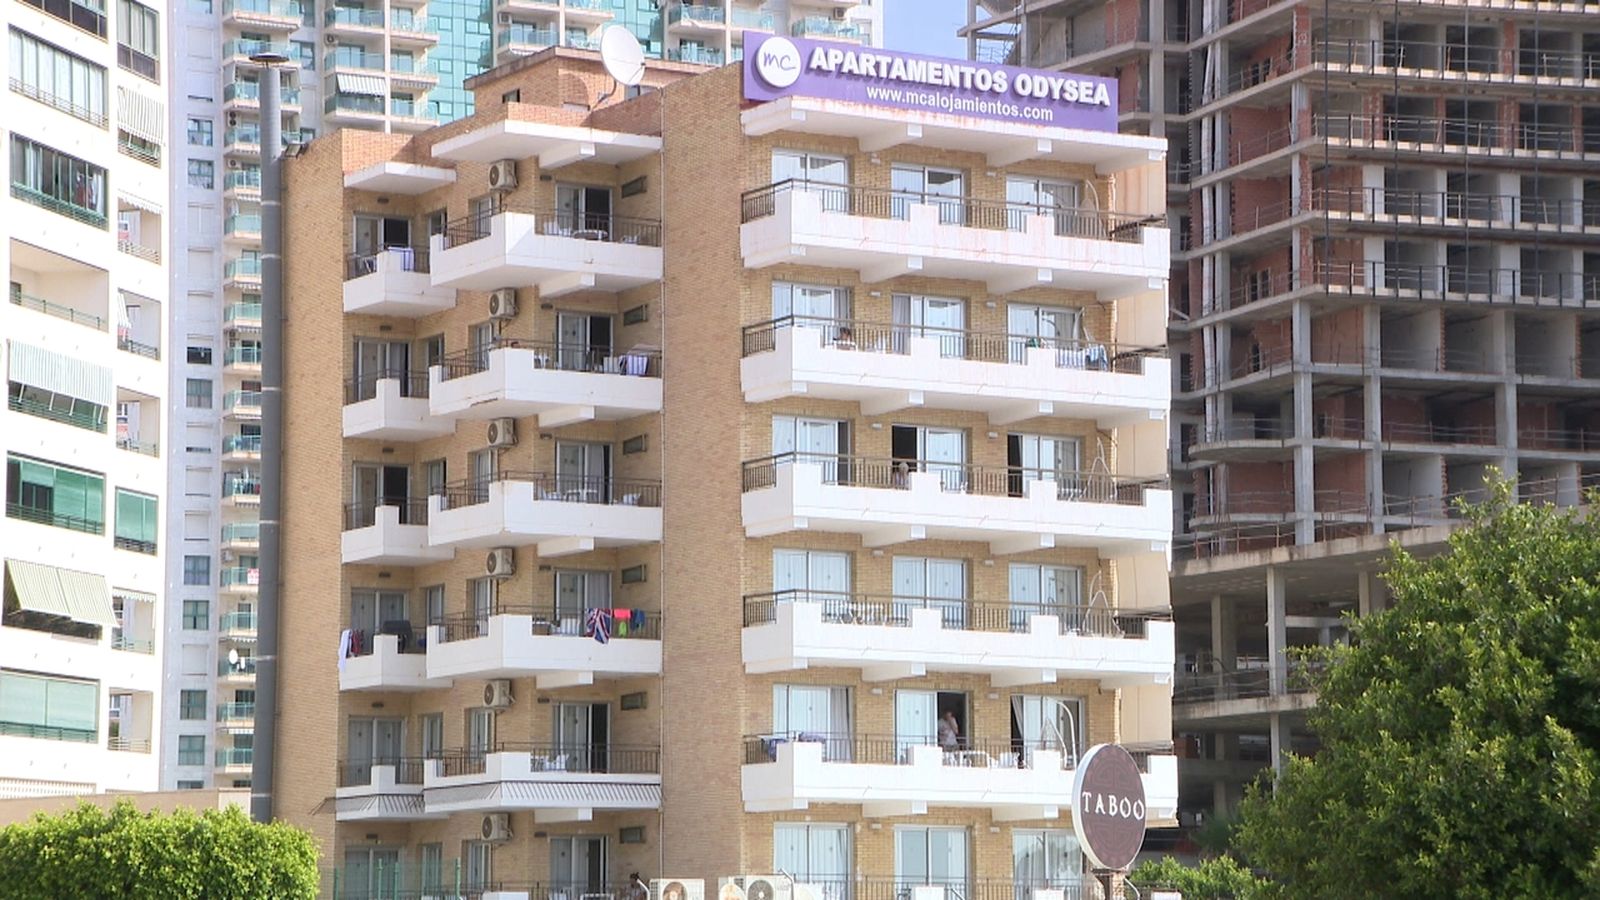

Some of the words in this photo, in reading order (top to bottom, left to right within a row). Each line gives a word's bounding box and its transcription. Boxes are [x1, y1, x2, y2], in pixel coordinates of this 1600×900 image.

[809, 46, 1008, 94] APARTAMENTOS
[1014, 73, 1111, 106] ODYSEA
[866, 86, 1054, 121] www.mcalojamientos.com
[1082, 791, 1145, 820] TABOO
